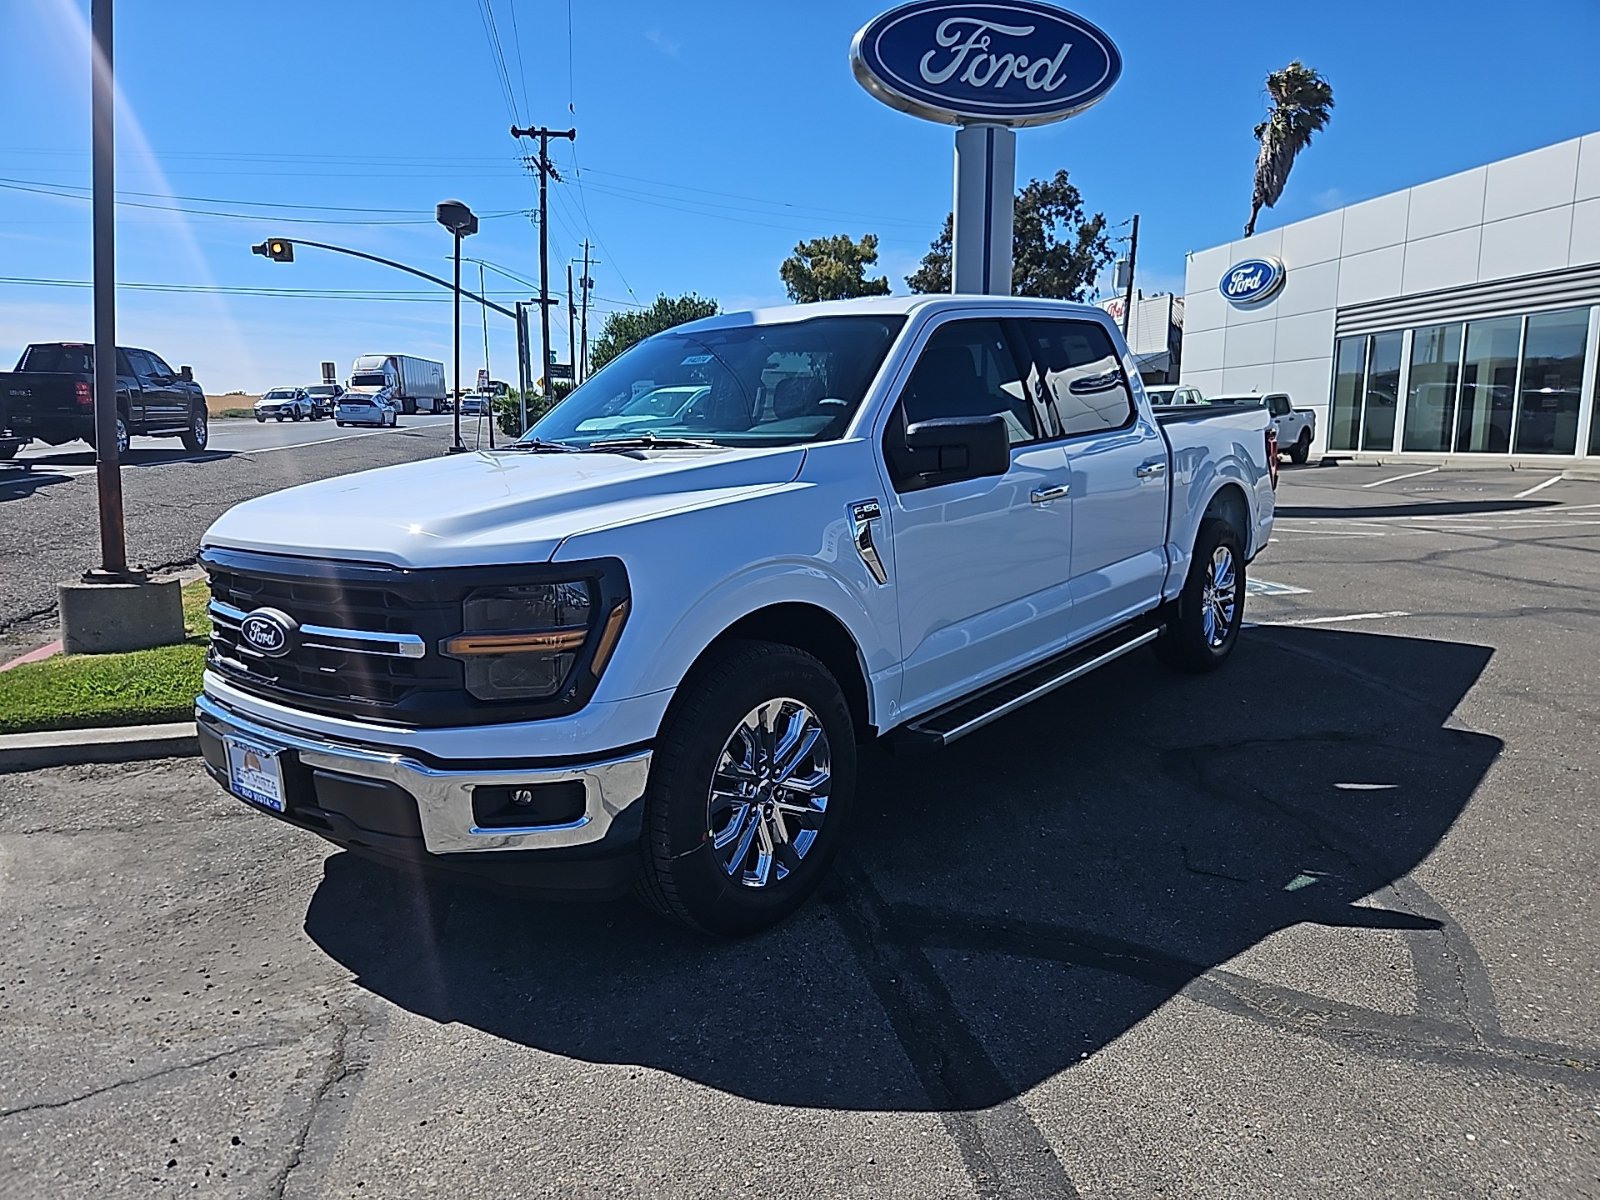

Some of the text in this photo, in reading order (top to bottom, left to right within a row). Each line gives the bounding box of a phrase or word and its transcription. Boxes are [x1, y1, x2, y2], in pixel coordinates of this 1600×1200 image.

[919, 17, 1074, 93] Ford
[1228, 266, 1263, 295] Ford
[854, 503, 879, 514] F-150
[249, 621, 276, 646] Ford
[241, 787, 271, 807] RIO VISTA
